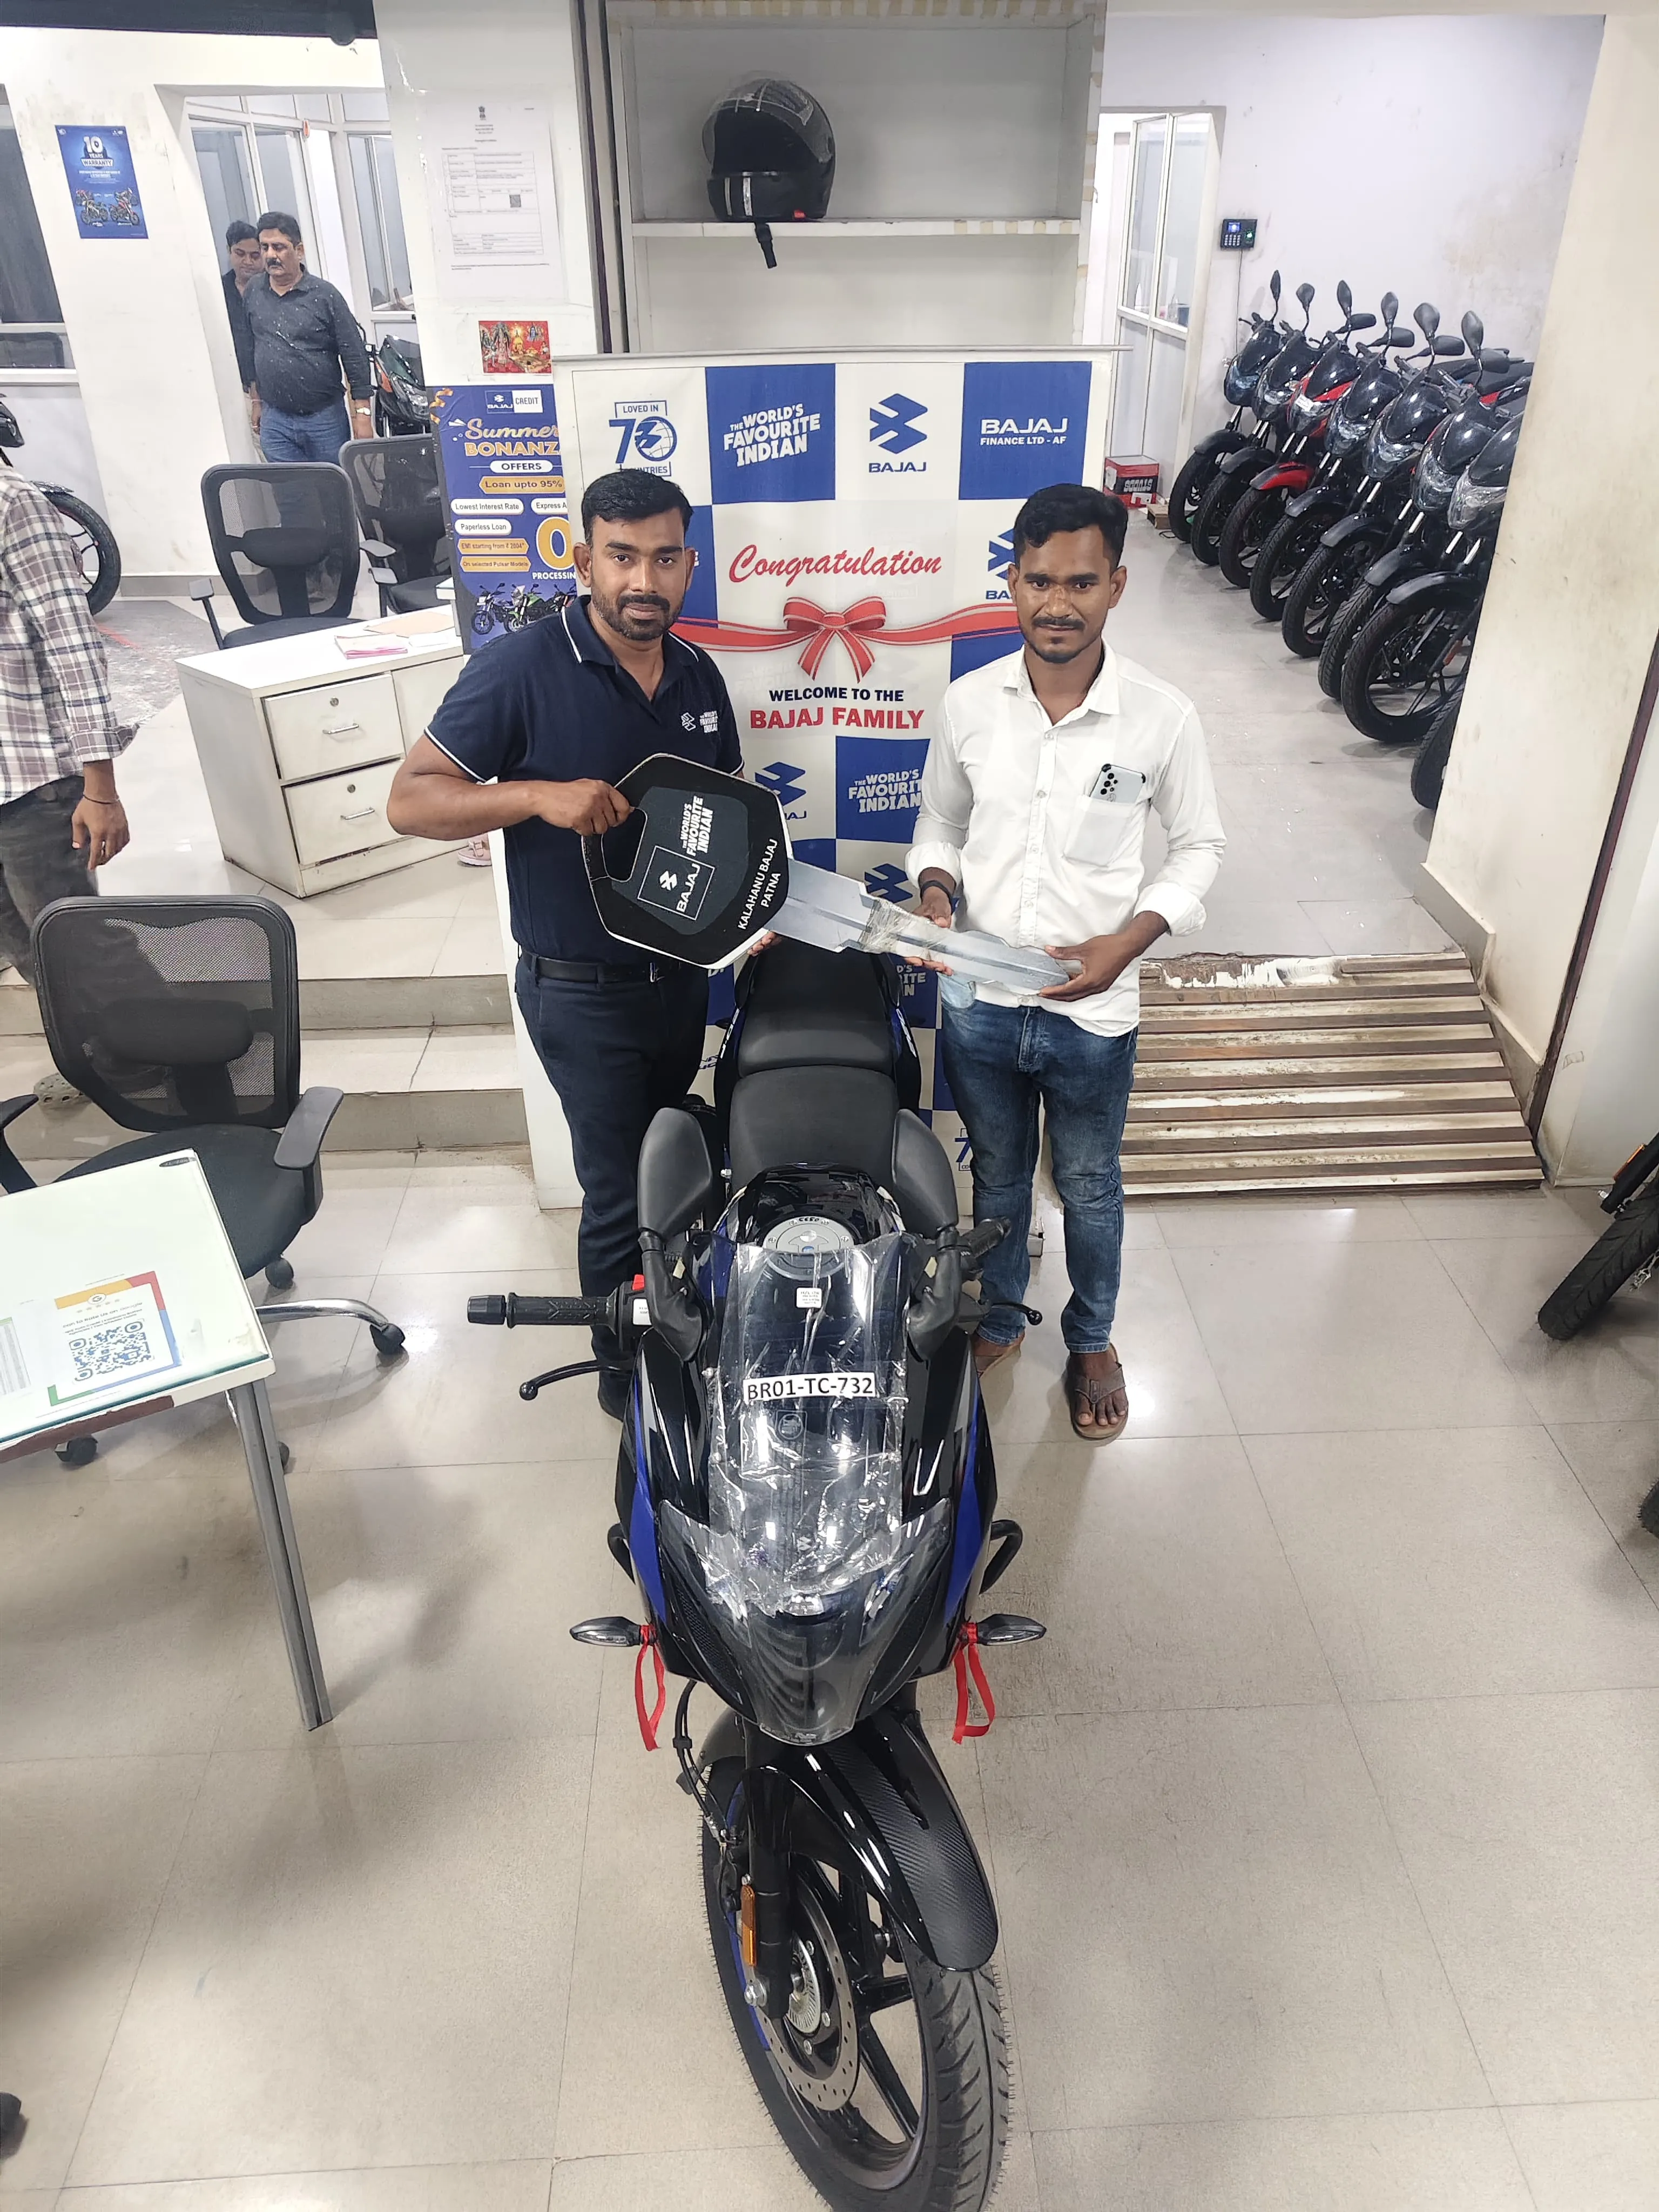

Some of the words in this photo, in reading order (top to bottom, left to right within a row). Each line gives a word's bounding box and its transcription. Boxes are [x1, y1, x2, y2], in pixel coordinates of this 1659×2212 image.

[84, 136, 103, 153] 10
[730, 422, 744, 431] THE
[743, 403, 804, 428] WORLD'S
[981, 418, 1068, 434] BAJAJ
[465, 418, 559, 440] Summer
[724, 413, 820, 450] FAVOURITE
[464, 442, 561, 456] BONANZ
[737, 434, 807, 467] INDIAN
[980, 437, 1024, 446] FINANCE
[1027, 436, 1044, 444] LTD
[1052, 436, 1067, 444] AF
[868, 462, 926, 473] BAJAJ
[729, 544, 942, 587] Congratulation
[769, 687, 847, 702] WELCOME
[851, 689, 870, 700] TO
[875, 690, 904, 702] THE
[750, 707, 824, 729] BAJAJ
[832, 707, 925, 729] FAMILY
[866, 769, 919, 784] WORLD'S
[848, 779, 922, 799] FAVOURIT
[859, 792, 921, 813] INDIAN
[680, 803, 692, 840] WORLD'S
[686, 795, 704, 857] FAVOURITE
[697, 807, 713, 853] INDIAN
[676, 863, 700, 913] BAJAJ
[738, 872, 765, 929] KALAHANU
[759, 839, 778, 872] BAJAJ
[761, 873, 781, 908] PATNA
[747, 1377, 873, 1400] BR01-TC-732
